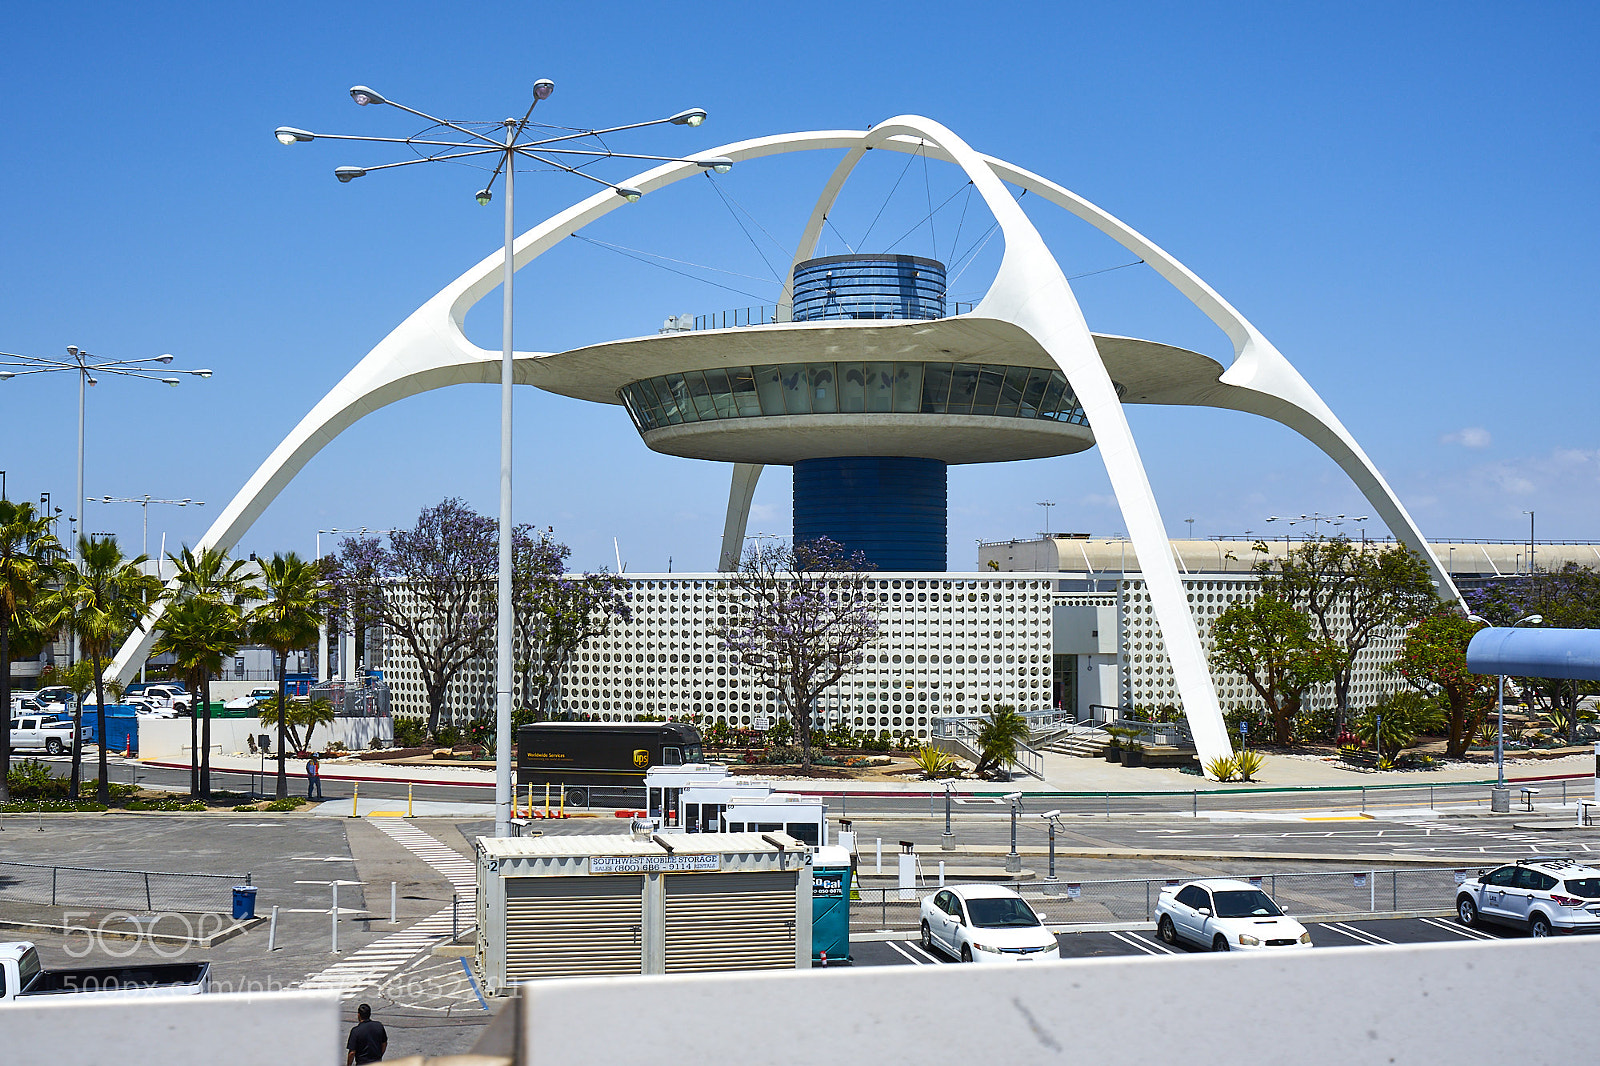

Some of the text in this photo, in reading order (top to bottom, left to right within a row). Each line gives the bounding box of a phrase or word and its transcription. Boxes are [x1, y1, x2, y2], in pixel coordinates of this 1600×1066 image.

[593, 855, 717, 866] SOUTHWEST MOBILE STORAGE
[805, 855, 812, 865] 2
[490, 861, 498, 872] 2
[615, 864, 640, 873] (800)
[669, 863, 691, 871] 9114
